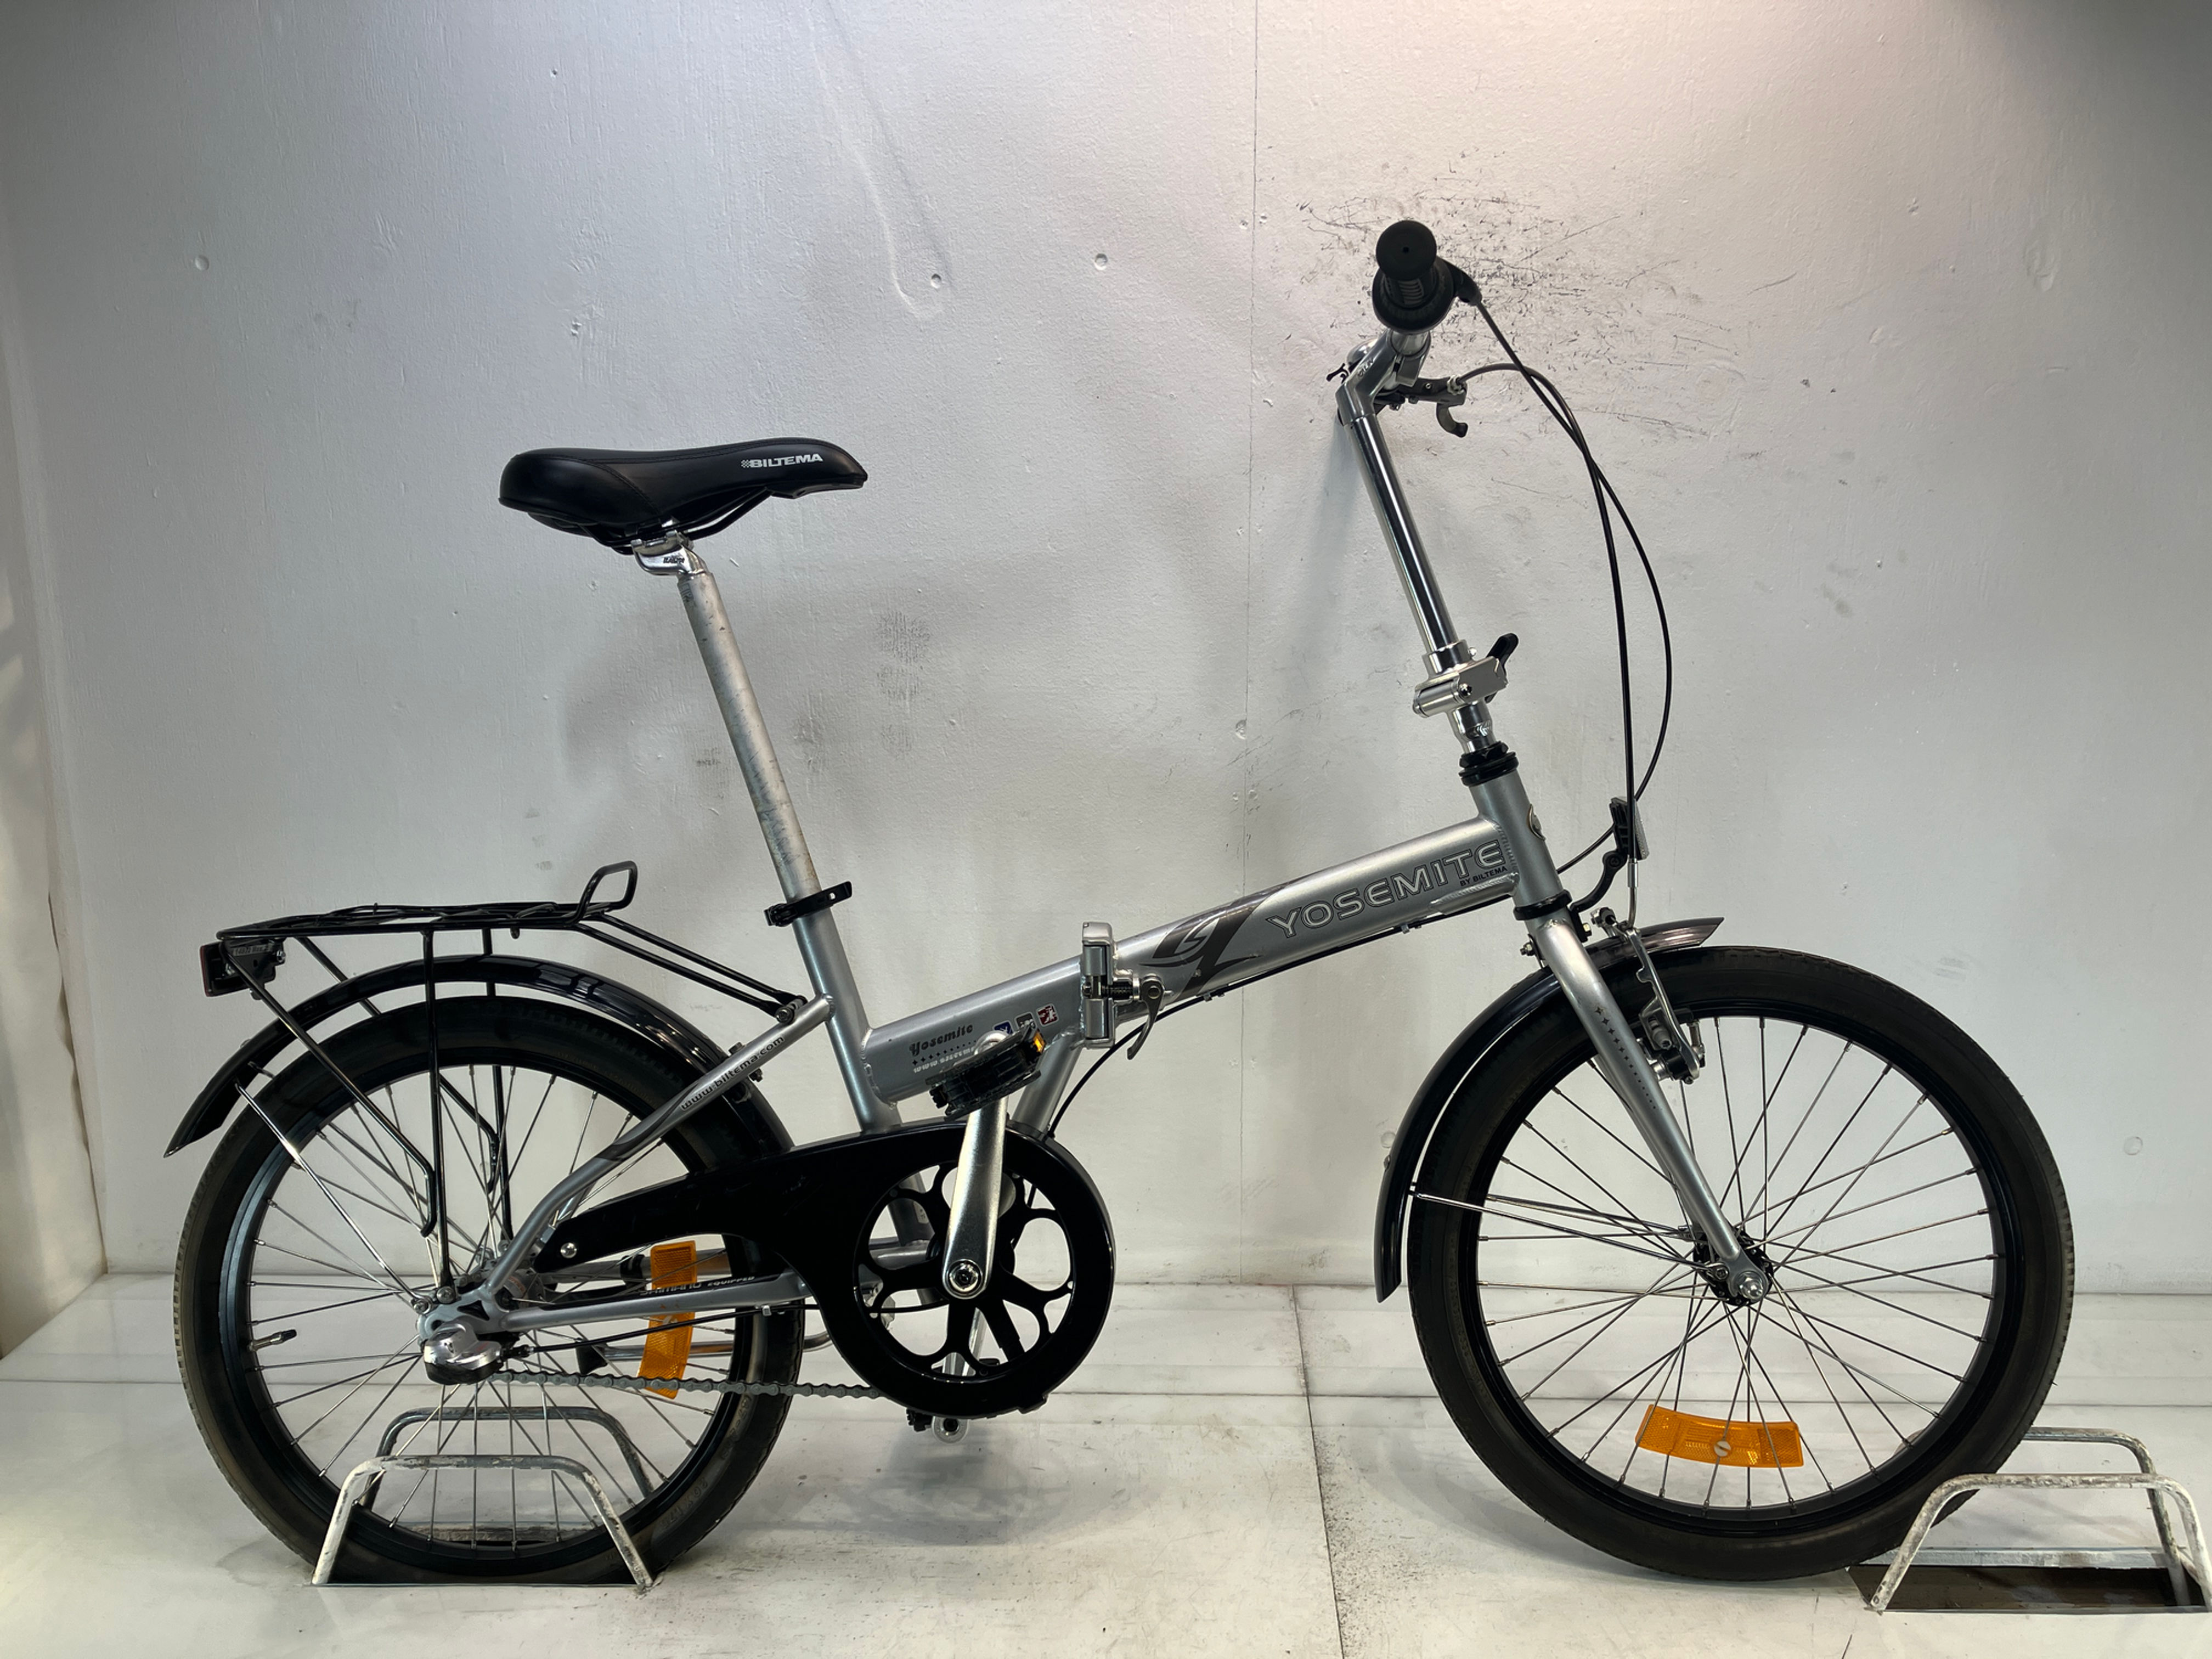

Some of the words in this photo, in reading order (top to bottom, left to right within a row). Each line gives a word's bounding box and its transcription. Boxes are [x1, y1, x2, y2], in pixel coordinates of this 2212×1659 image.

[750, 453, 823, 467] BILTEMA
[1266, 839, 1506, 939] YOSEMITE
[1460, 878, 1471, 887] BY
[1472, 866, 1508, 882] BILTEMA
[909, 1025, 973, 1056] Yosemite
[681, 1036, 785, 1110] www.biltema.com
